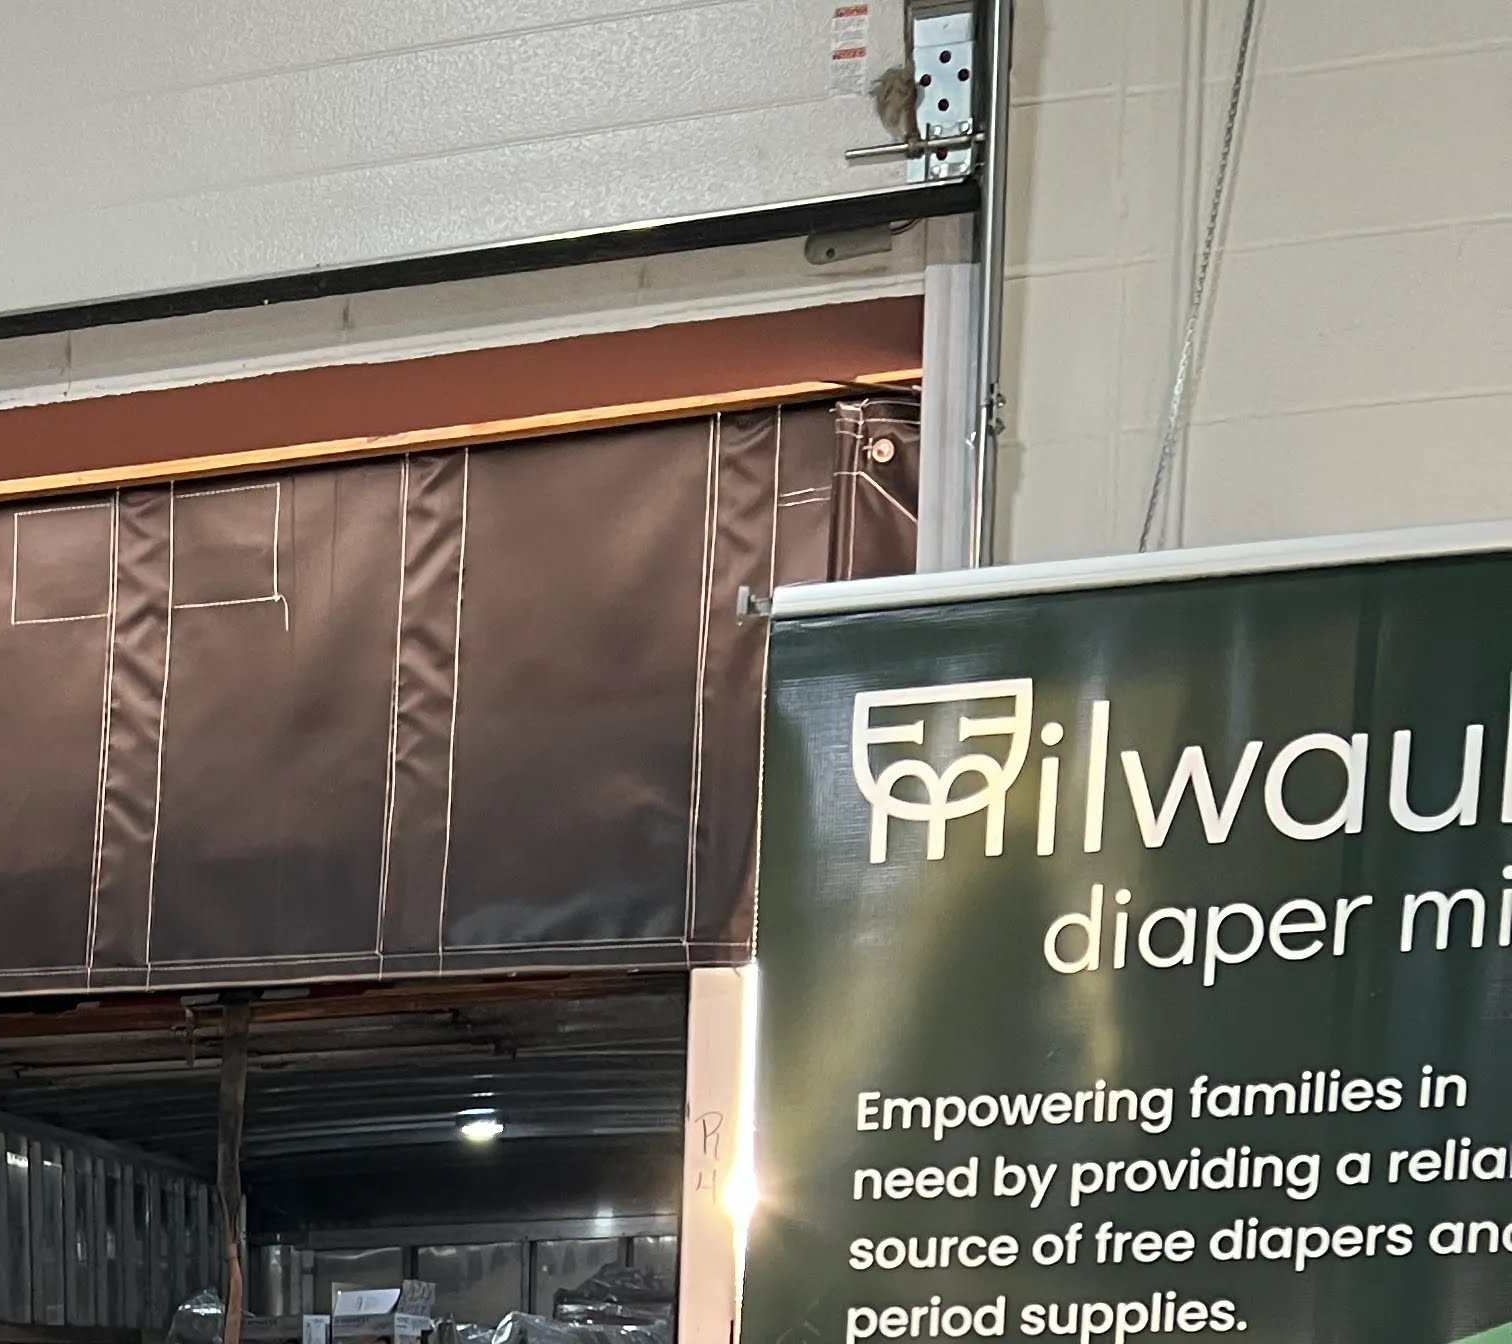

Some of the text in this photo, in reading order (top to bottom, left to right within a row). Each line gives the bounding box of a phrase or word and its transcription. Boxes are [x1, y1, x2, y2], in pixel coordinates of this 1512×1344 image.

[852, 678, 1512, 864] milwau
[1043, 883, 1373, 986] diaper
[857, 1064, 1467, 1141] Empowering families in
[853, 1137, 1512, 1209] need by providing a relia
[848, 1235, 1019, 1270] source
[1032, 1222, 1083, 1265] of
[1094, 1221, 1195, 1264] free
[1209, 1217, 1414, 1272] diapers
